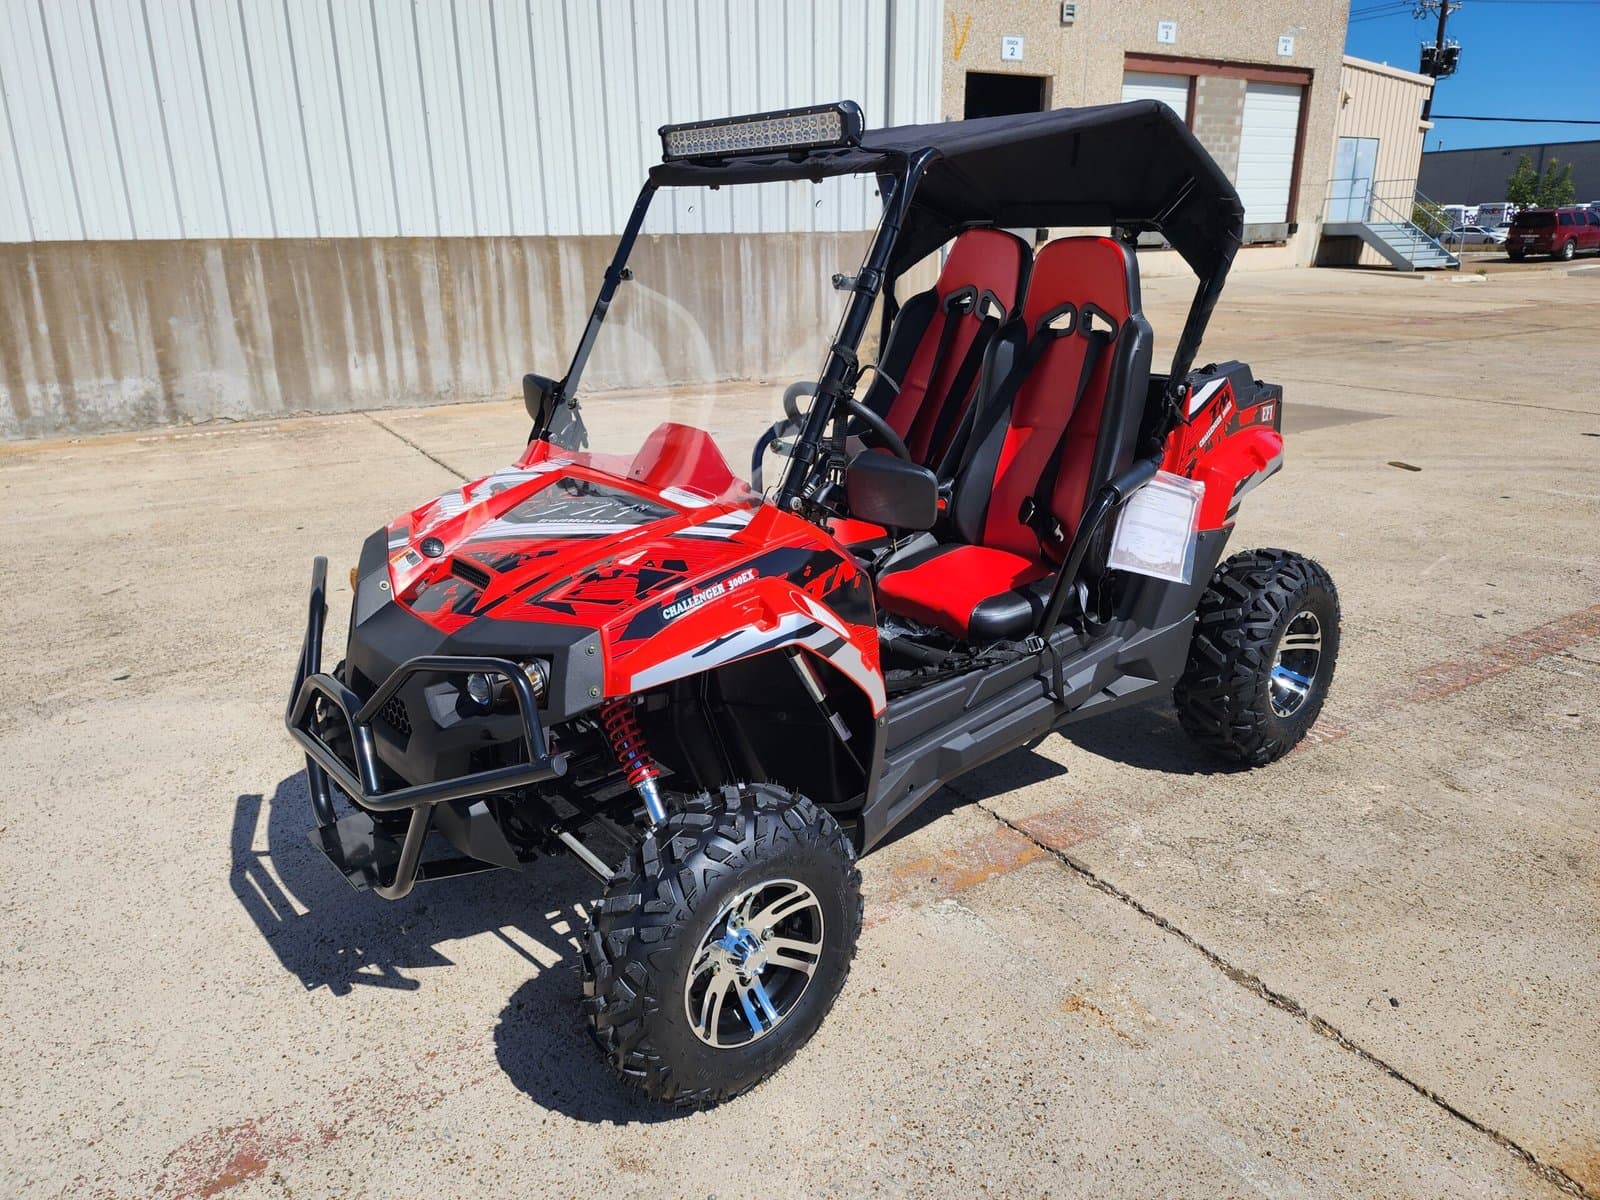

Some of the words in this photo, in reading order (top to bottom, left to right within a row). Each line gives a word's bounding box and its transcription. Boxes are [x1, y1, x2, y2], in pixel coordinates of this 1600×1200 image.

[1464, 209, 1479, 225] Fed
[662, 582, 726, 620] CHALLENGER
[727, 568, 755, 591] 300EX
